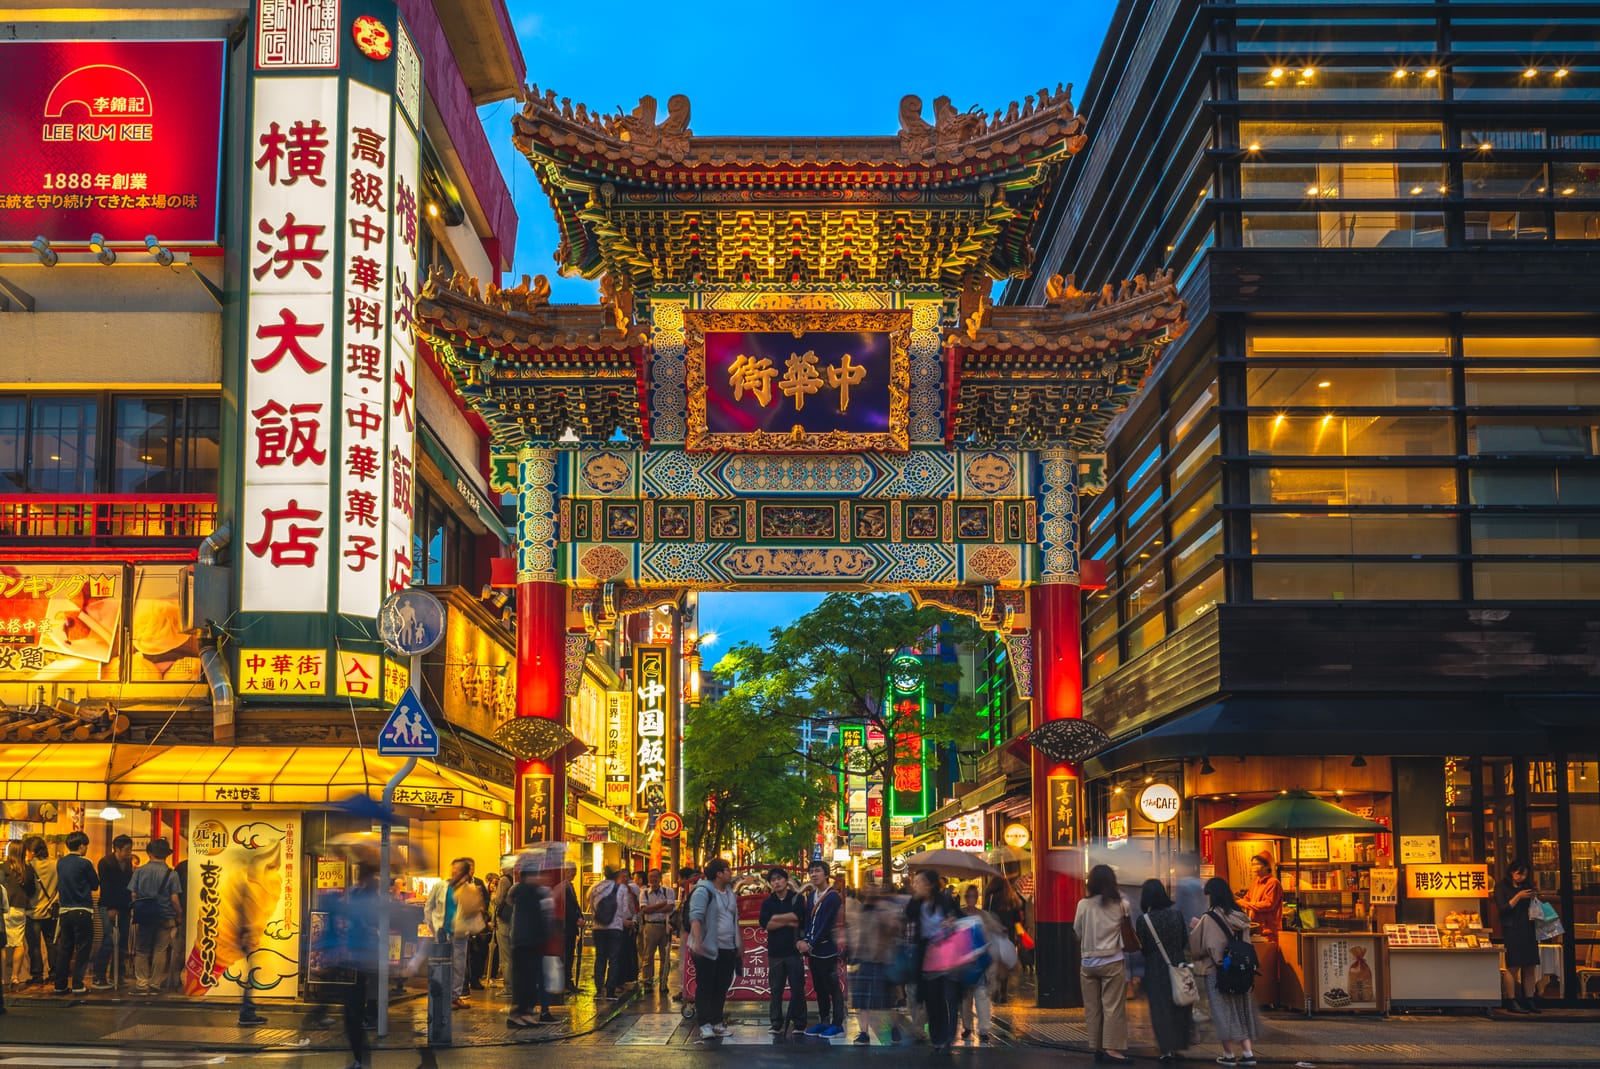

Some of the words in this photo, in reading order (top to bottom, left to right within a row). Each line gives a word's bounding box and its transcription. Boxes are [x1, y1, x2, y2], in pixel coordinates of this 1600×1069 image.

[93, 97, 145, 112] 李錦記
[43, 124, 73, 141] LEE
[77, 124, 115, 141] KUM
[120, 124, 152, 141] KEE
[43, 173, 147, 190] 1888年創業
[246, 120, 329, 568] 横浜大飯店
[727, 349, 868, 412] 中華街
[246, 654, 322, 676] 中華街
[245, 677, 321, 690] 大通り入口
[1156, 797, 1177, 809] CAFE
[662, 819, 677, 831] 30
[319, 870, 343, 881] 20%
[1415, 871, 1486, 891] 聘珍大甘栗
